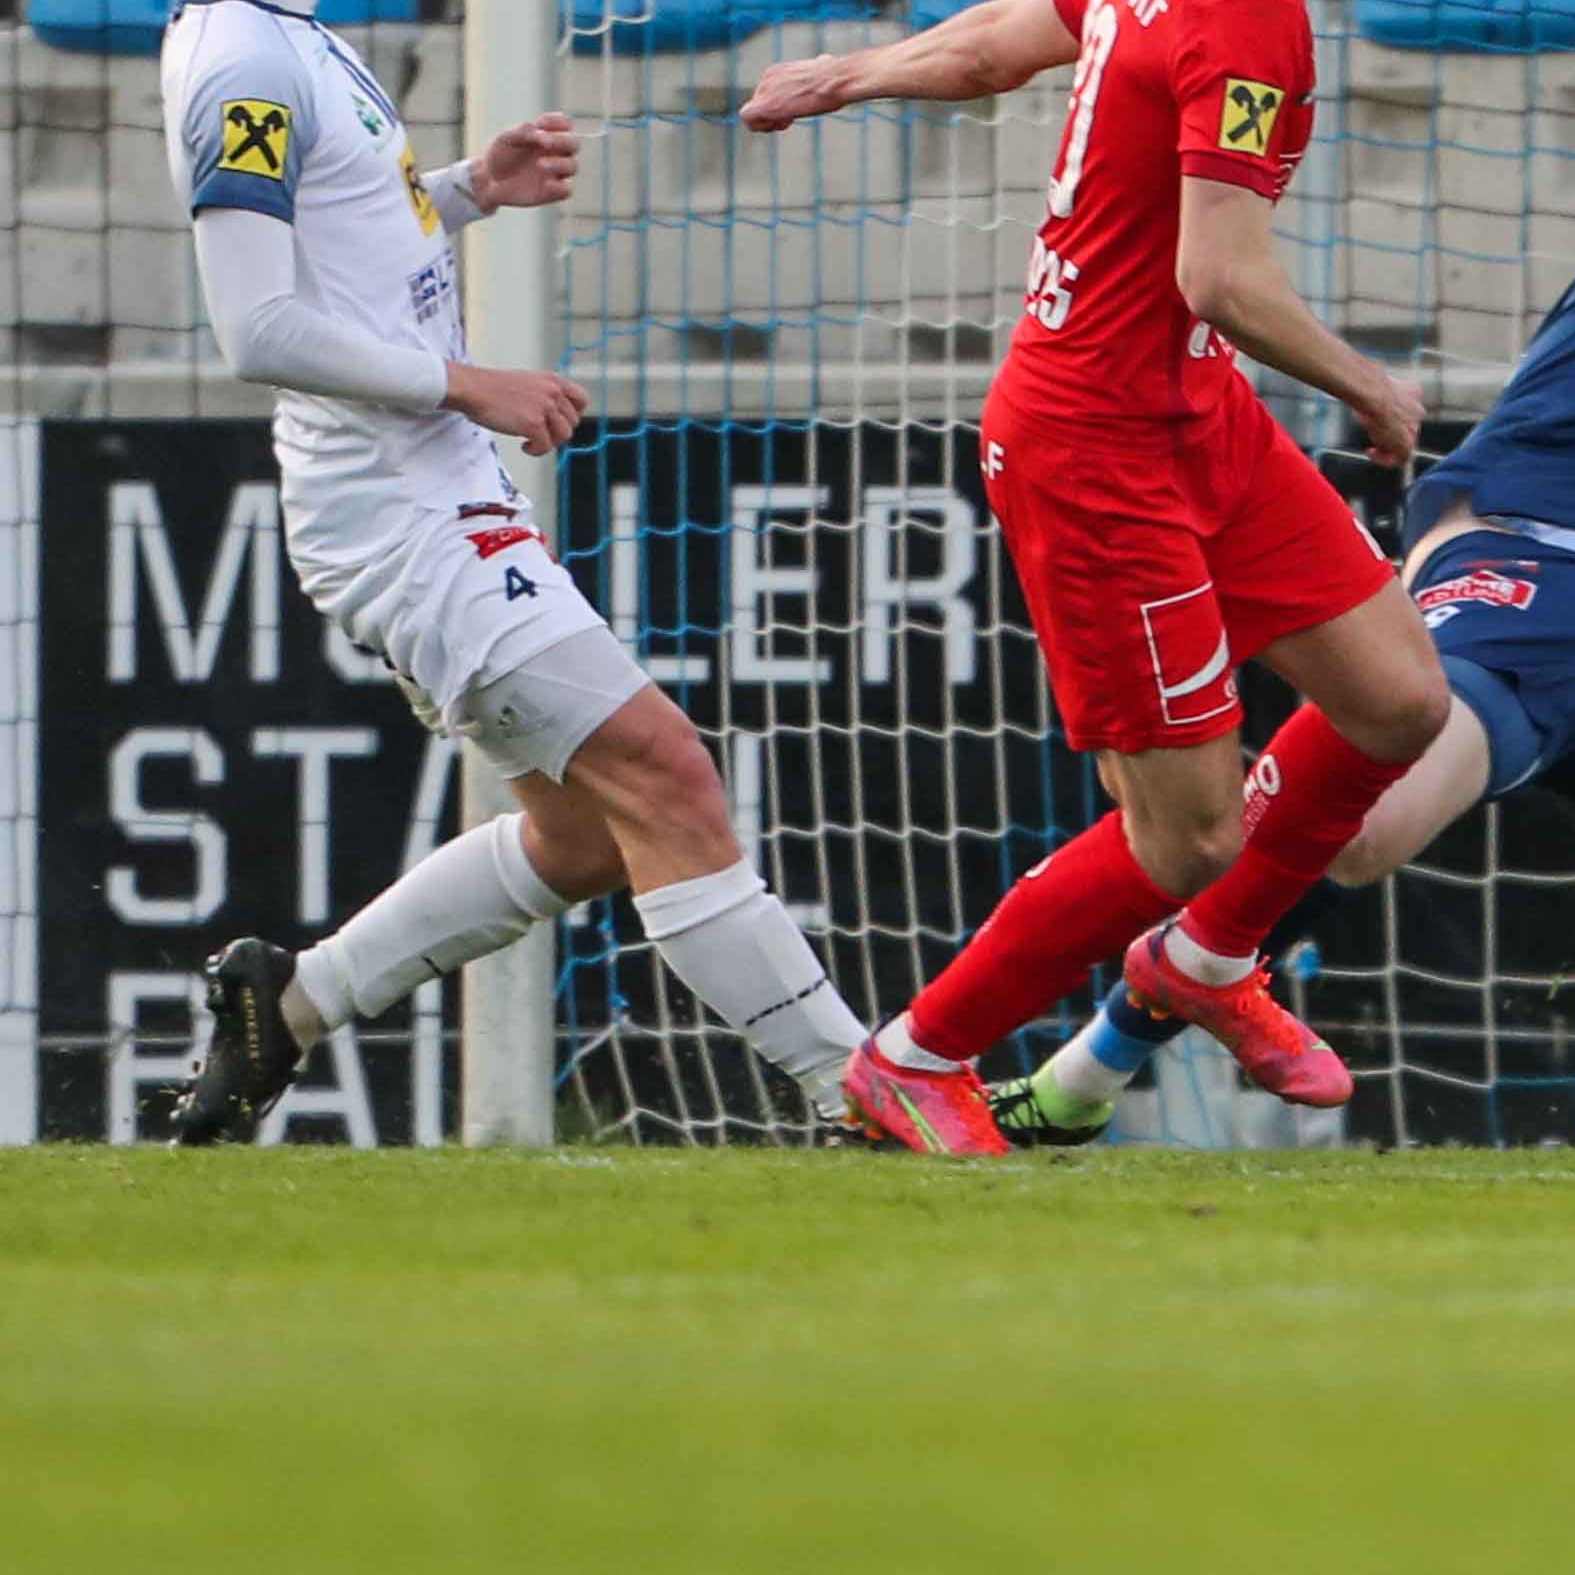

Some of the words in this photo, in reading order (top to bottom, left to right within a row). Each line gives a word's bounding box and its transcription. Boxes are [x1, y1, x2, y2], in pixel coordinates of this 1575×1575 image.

[104, 483, 978, 683] MLER
[505, 565, 539, 602] 4
[105, 728, 831, 926] STL
